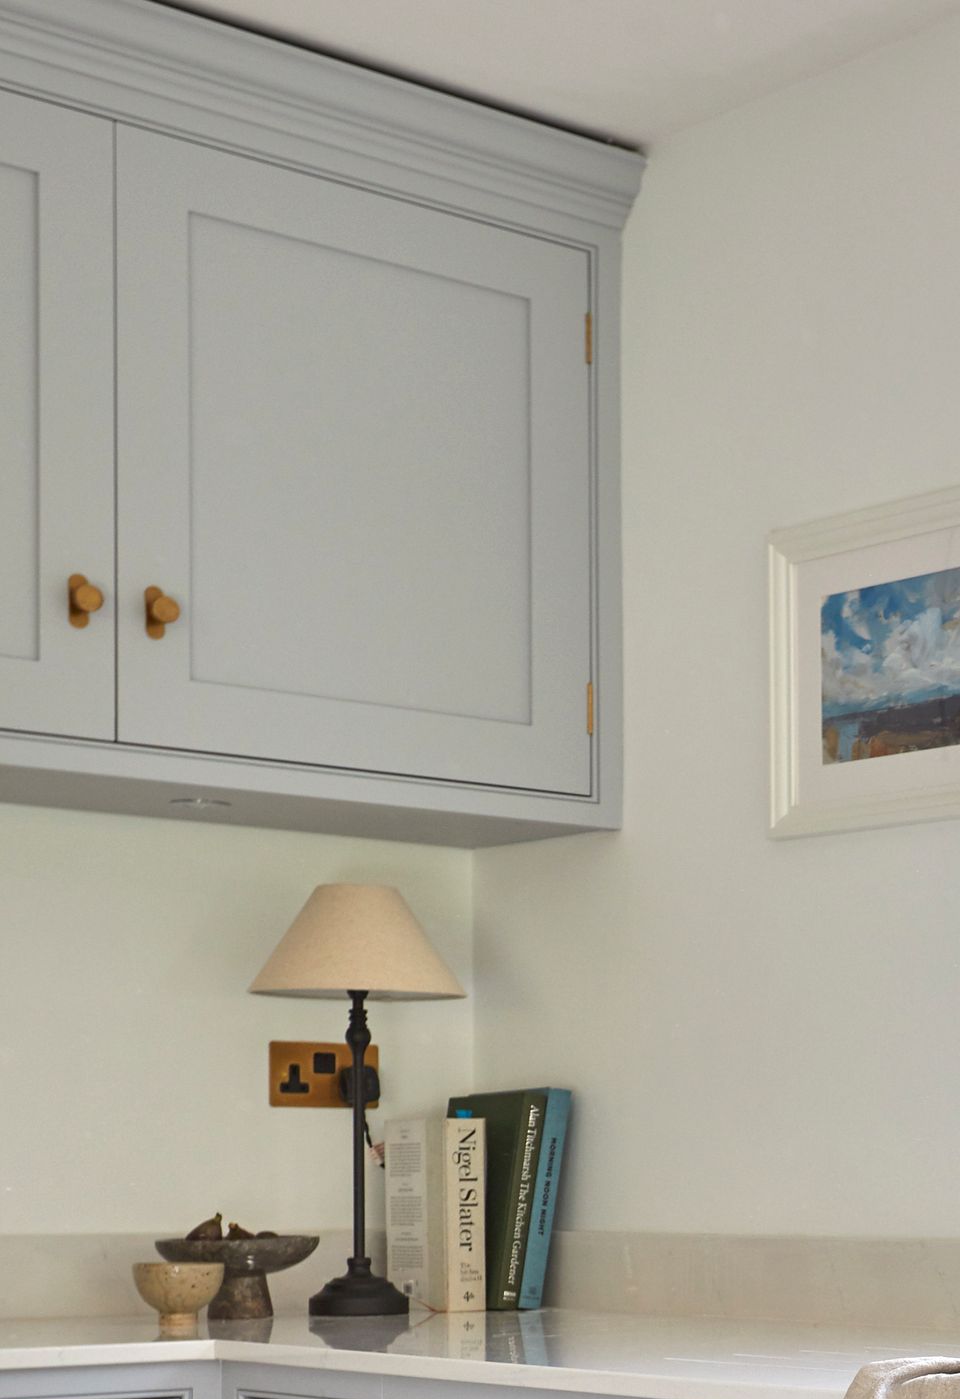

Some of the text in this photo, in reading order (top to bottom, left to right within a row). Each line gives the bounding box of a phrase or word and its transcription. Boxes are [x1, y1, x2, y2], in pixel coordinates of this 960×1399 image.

[528, 1104, 540, 1127] Alan
[452, 1128, 478, 1182] Nigel
[521, 1129, 537, 1181] Titchmarsh
[518, 1183, 530, 1201] The
[537, 1137, 557, 1236] MORNING NOON NIGHT
[459, 1188, 479, 1252] Slater
[513, 1202, 527, 1239] Kitchen
[508, 1240, 521, 1285] Gardener
